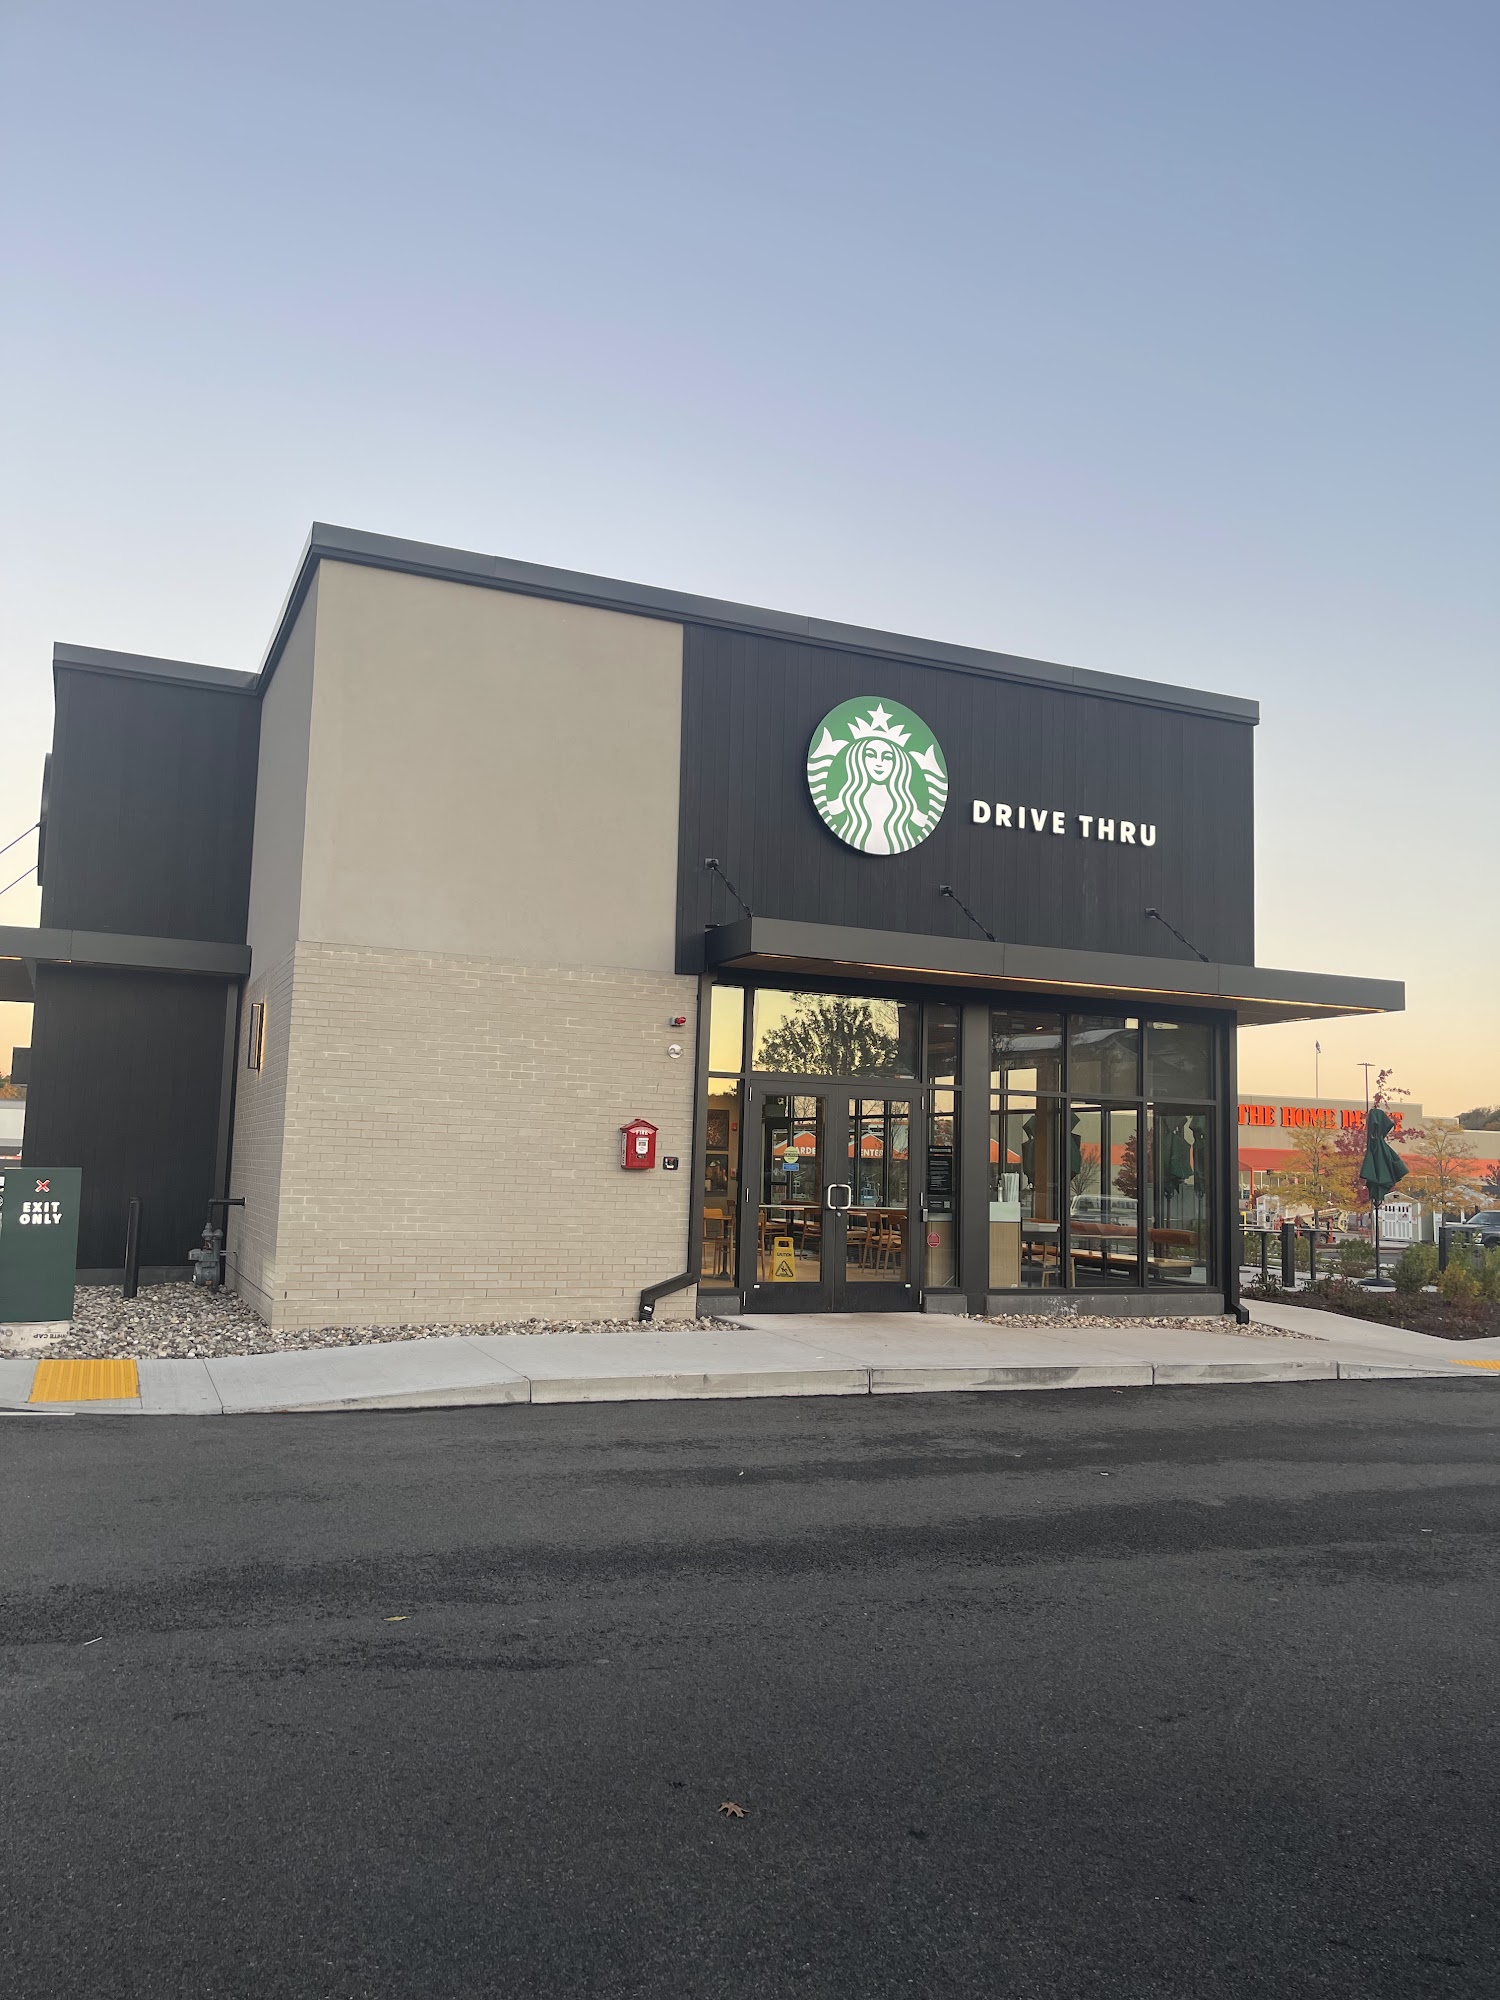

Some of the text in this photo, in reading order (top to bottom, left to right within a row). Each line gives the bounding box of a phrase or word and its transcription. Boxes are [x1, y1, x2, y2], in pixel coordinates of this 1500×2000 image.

[972, 799, 1157, 847] DRIVE THRU
[1237, 1103, 1404, 1132] THE HOME DET
[22, 1201, 60, 1213] EXIT
[19, 1213, 63, 1225] ONLY
